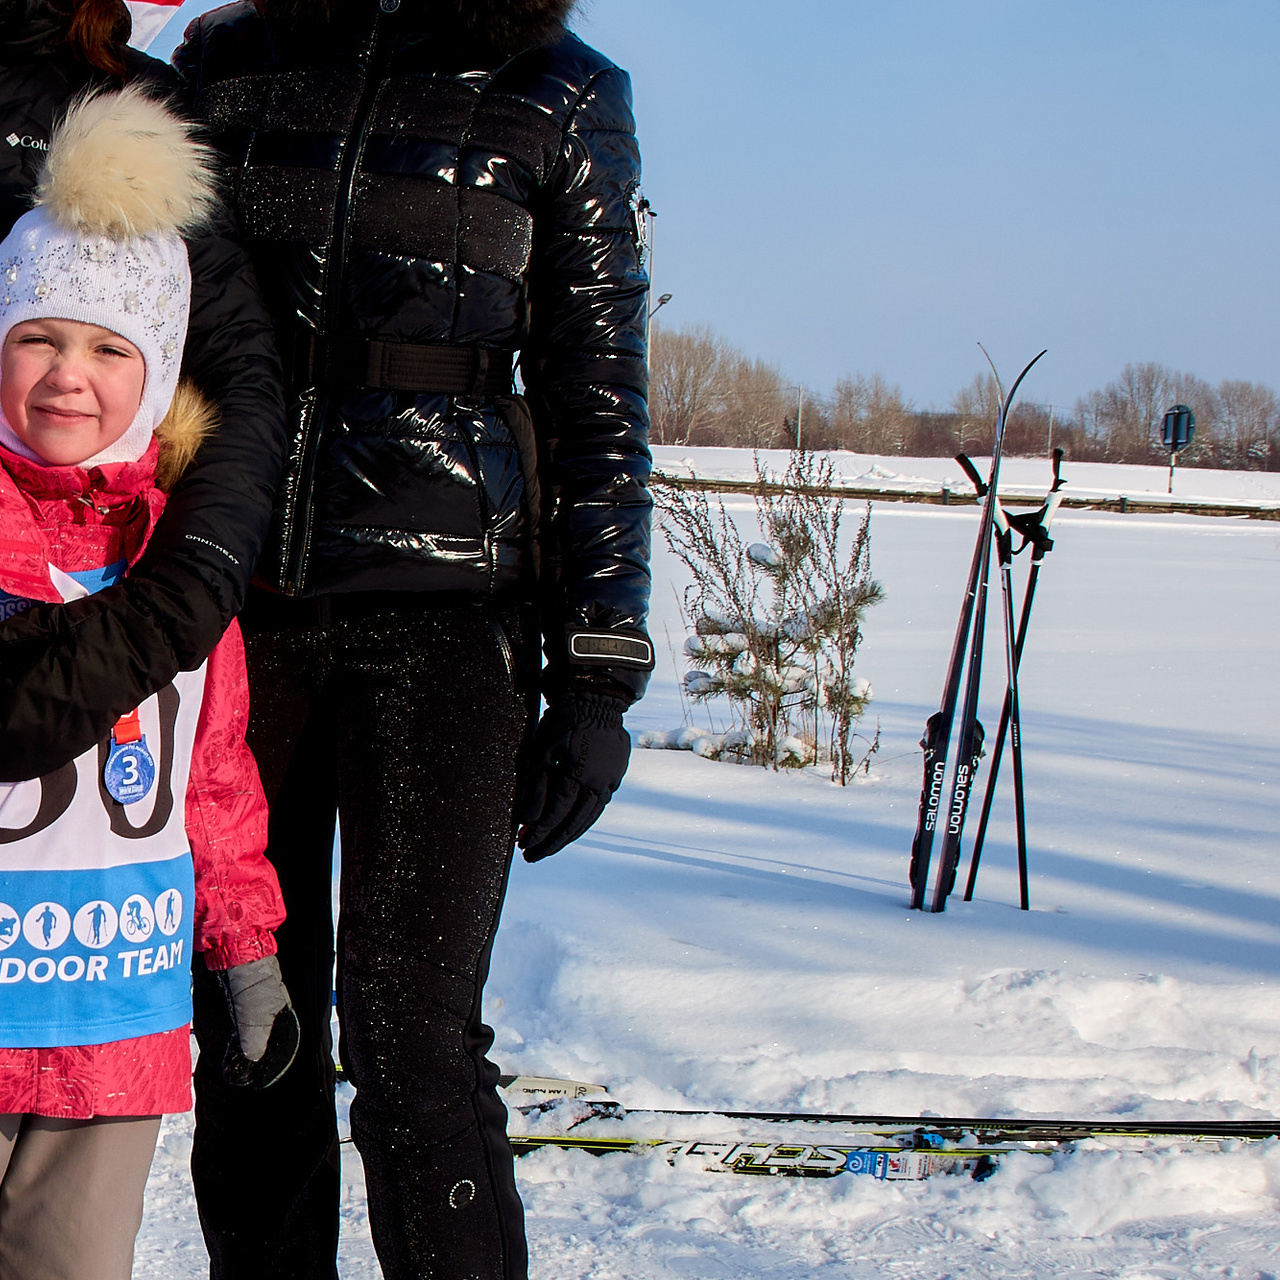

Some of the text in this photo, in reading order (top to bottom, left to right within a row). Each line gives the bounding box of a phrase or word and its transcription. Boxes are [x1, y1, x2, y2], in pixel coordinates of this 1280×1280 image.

[20, 135, 50, 152] Colu
[185, 534, 240, 565] OMNI-HEAT
[121, 755, 139, 786] 3
[117, 938, 184, 979] TEAM
